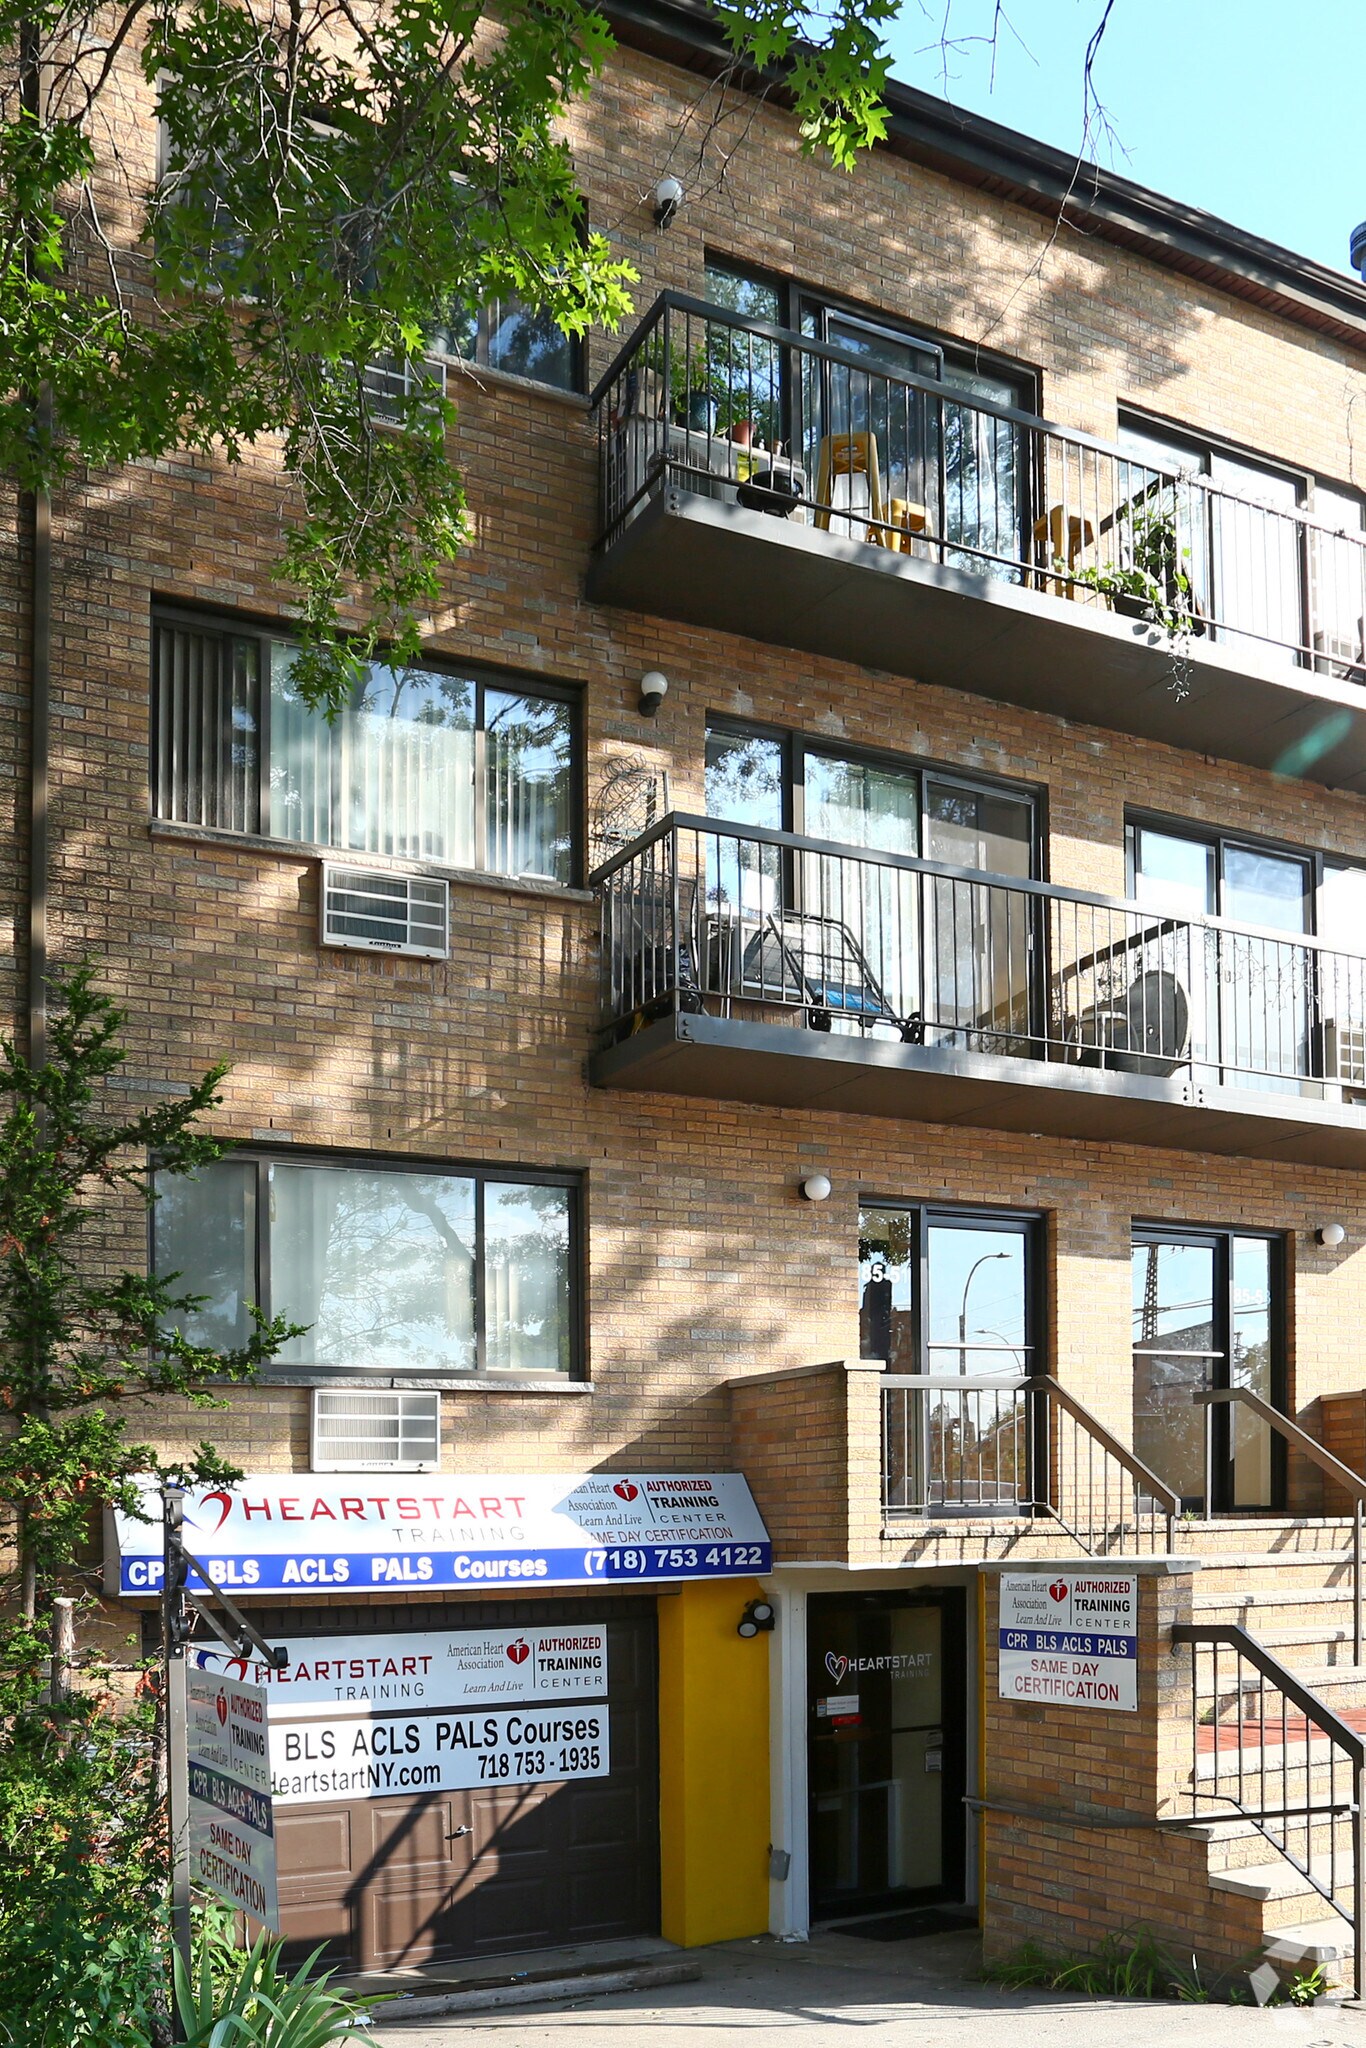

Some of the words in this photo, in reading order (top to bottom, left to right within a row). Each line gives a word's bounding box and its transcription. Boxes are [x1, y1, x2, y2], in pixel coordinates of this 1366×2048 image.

[862, 1264, 907, 1284] 85-51
[588, 1482, 612, 1494] Heart
[646, 1480, 712, 1492] AUTHORIZED
[244, 1498, 526, 1520] HEARTSTART
[568, 1499, 618, 1511] Association
[650, 1496, 720, 1508] TRAINING
[579, 1515, 604, 1526] Learn
[604, 1514, 622, 1526] And
[624, 1514, 642, 1525] Live
[660, 1513, 726, 1524] CENTER
[392, 1526, 525, 1543] TRAINING
[583, 1531, 616, 1545] AME
[618, 1530, 642, 1543] DAY
[646, 1527, 734, 1542] CERTIFICATION
[128, 1560, 165, 1586] CP
[208, 1560, 260, 1584] BLS
[282, 1558, 350, 1584] ACLS
[371, 1557, 434, 1582] PALS
[454, 1556, 548, 1580] Courses
[584, 1550, 646, 1576] (718)
[655, 1549, 698, 1568] 753
[705, 1547, 762, 1566] 4122
[1006, 1581, 1031, 1592] American
[1031, 1580, 1047, 1592] Heart
[1075, 1581, 1130, 1594] AUTHORIZED
[1012, 1598, 1047, 1610] Association
[1075, 1599, 1130, 1612] TRAINING
[1016, 1613, 1034, 1625] Learn
[1034, 1614, 1048, 1625] And
[1048, 1614, 1062, 1626] Live
[1076, 1618, 1130, 1628] CENTER
[447, 1644, 482, 1658] American
[483, 1642, 504, 1656] Heart
[538, 1636, 601, 1652] AUTHORIZED
[1006, 1632, 1028, 1648] CPR
[1036, 1634, 1056, 1650] BLS
[1062, 1637, 1092, 1653] ACLS
[1098, 1639, 1128, 1655] PALS
[256, 1656, 432, 1684] HEARTSTART
[457, 1658, 504, 1671] Association
[538, 1656, 602, 1671] TRAINING
[848, 1654, 932, 1672] HEARTSTART
[1031, 1659, 1068, 1674] SAME
[1072, 1662, 1099, 1676] DAY
[540, 1676, 602, 1688] CENTER
[890, 1669, 930, 1679] TRAINING
[334, 1682, 424, 1700] TRAINING
[463, 1682, 486, 1694] Learn
[487, 1682, 504, 1692] And
[504, 1681, 524, 1692] Live
[1015, 1676, 1119, 1701] CERTIFICATION
[231, 1694, 262, 1723] AUTHORIZED
[232, 1724, 264, 1756] TRAINING
[286, 1730, 335, 1761] BLS
[352, 1724, 420, 1757] ACLS
[436, 1718, 498, 1750] PALS
[506, 1717, 600, 1745] Courses
[478, 1754, 508, 1778] 718
[514, 1750, 544, 1776] 753
[559, 1746, 600, 1772] 1935
[234, 1758, 267, 1786] CENTER
[194, 1769, 208, 1797] CPR
[212, 1777, 226, 1806] BLS
[228, 1785, 246, 1817] ACLS
[248, 1795, 267, 1830] PALS
[210, 1823, 235, 1854] SAME
[235, 1840, 252, 1866] DAY
[200, 1848, 266, 1916] CERTIFICATION
